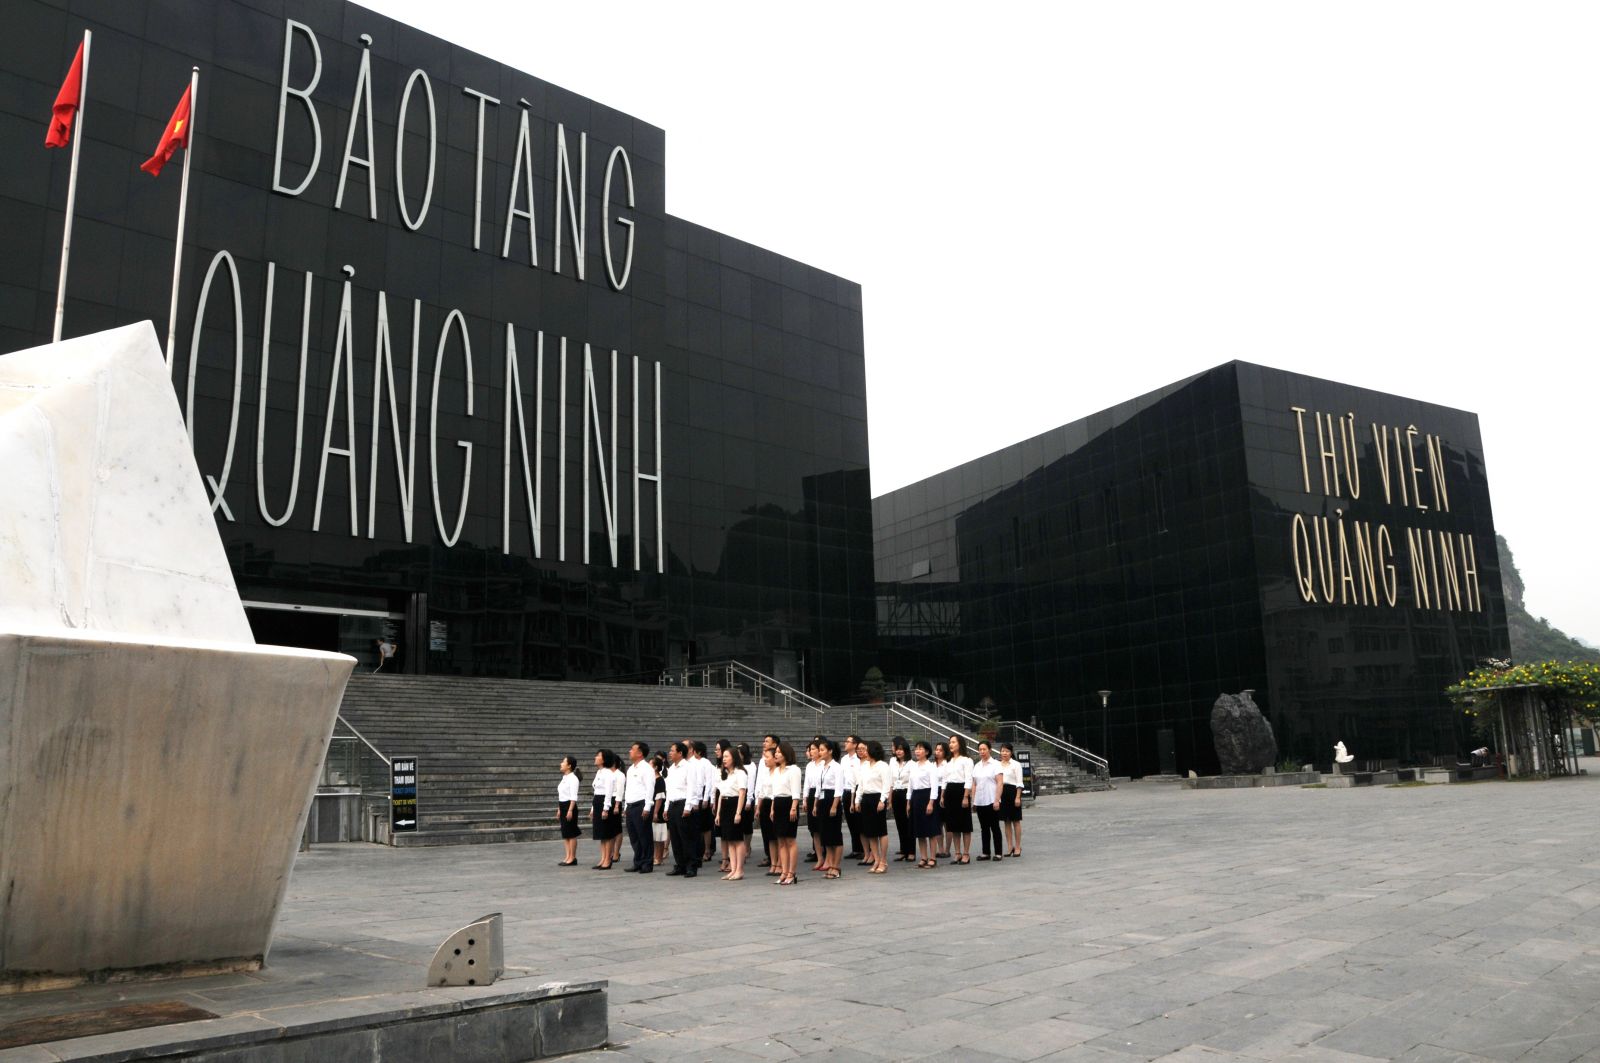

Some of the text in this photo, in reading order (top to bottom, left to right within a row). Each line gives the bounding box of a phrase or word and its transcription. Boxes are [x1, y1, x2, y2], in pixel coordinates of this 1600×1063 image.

[272, 18, 635, 291] BẢO TÀNG
[187, 250, 664, 574] QUẢNG NINH
[1291, 406, 1449, 514] THƯ VIỆN
[1292, 508, 1481, 613] QUẢNG NINH
